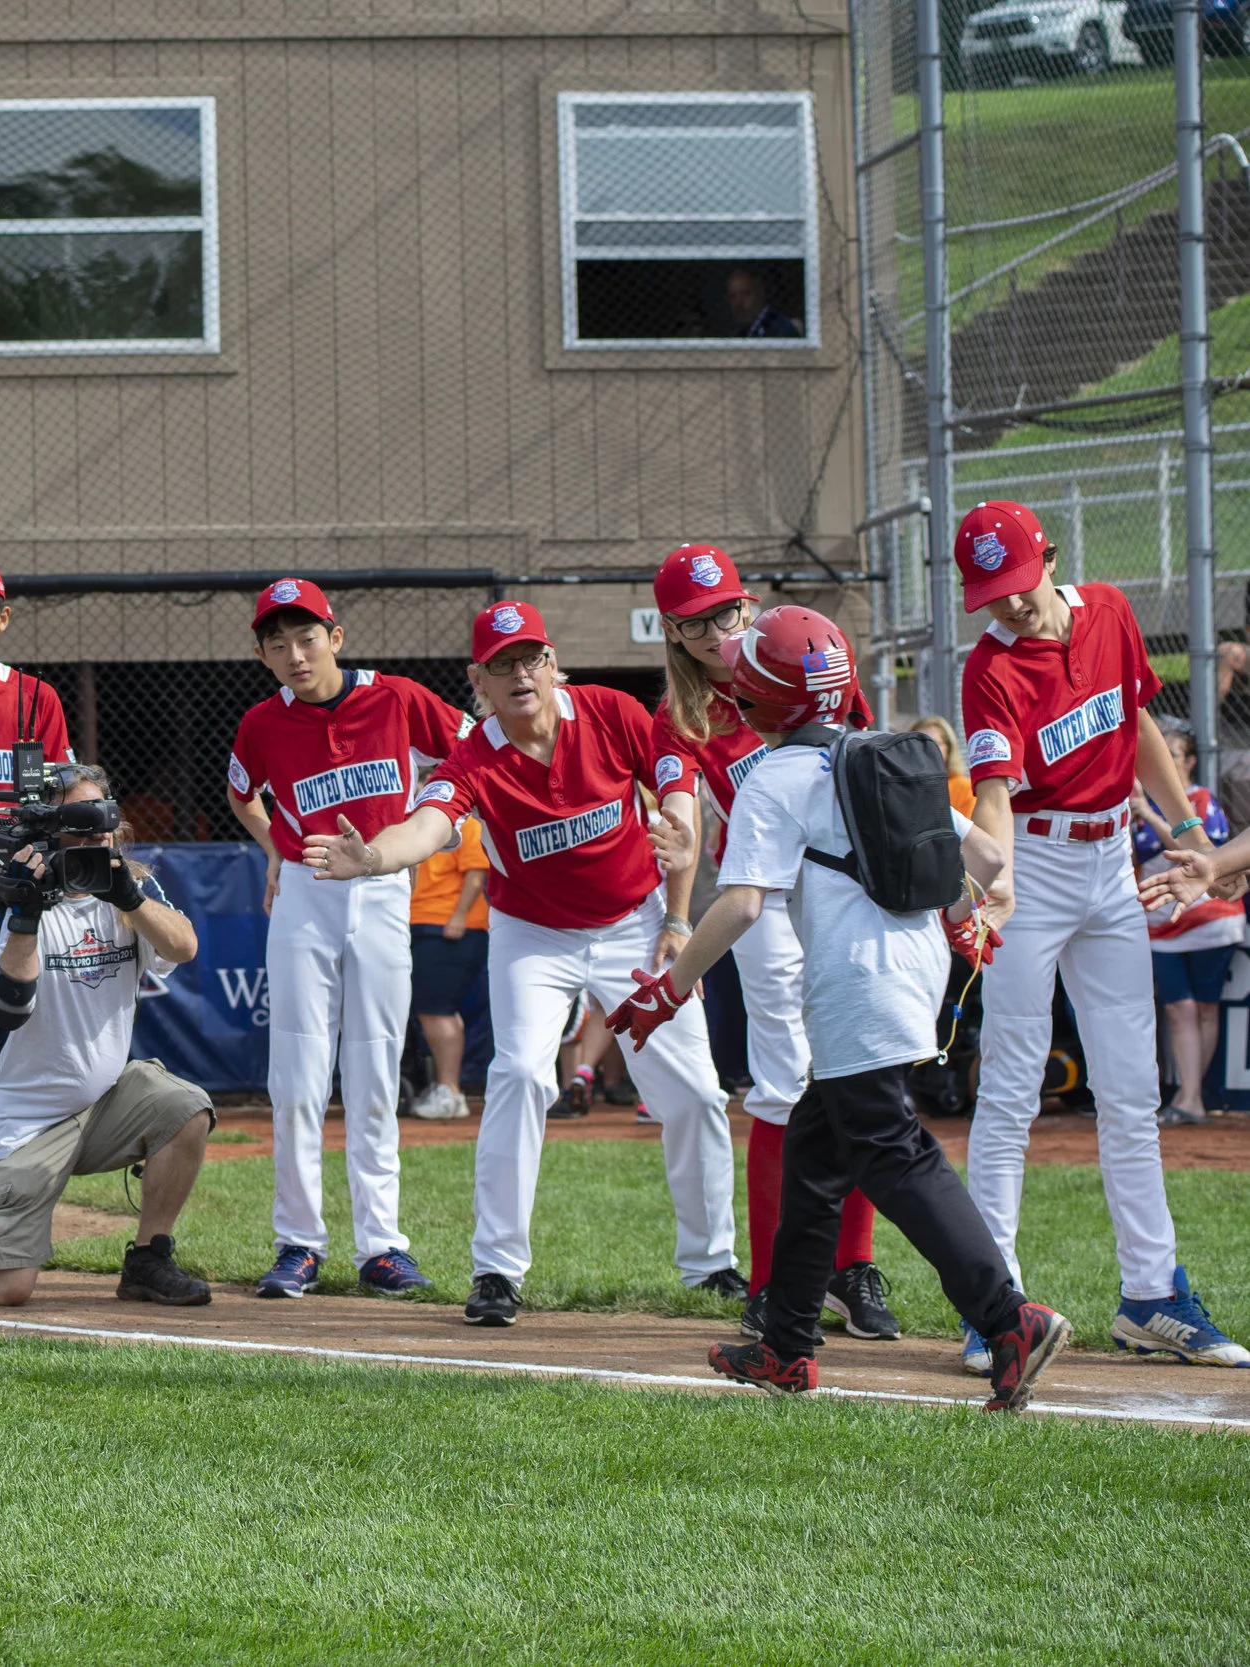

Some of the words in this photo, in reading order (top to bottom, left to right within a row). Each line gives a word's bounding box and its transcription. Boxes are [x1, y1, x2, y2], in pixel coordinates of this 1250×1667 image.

[815, 690, 842, 712] 20
[1041, 709, 1086, 762] UNITED
[1085, 689, 1125, 737] KINGD
[296, 770, 341, 813] UNITED
[340, 761, 401, 799] KINGDOM
[519, 822, 568, 860] UNITED
[569, 802, 620, 845] KINGDOM
[76, 957, 91, 967] PRO
[1143, 1312, 1199, 1348] NIKE
